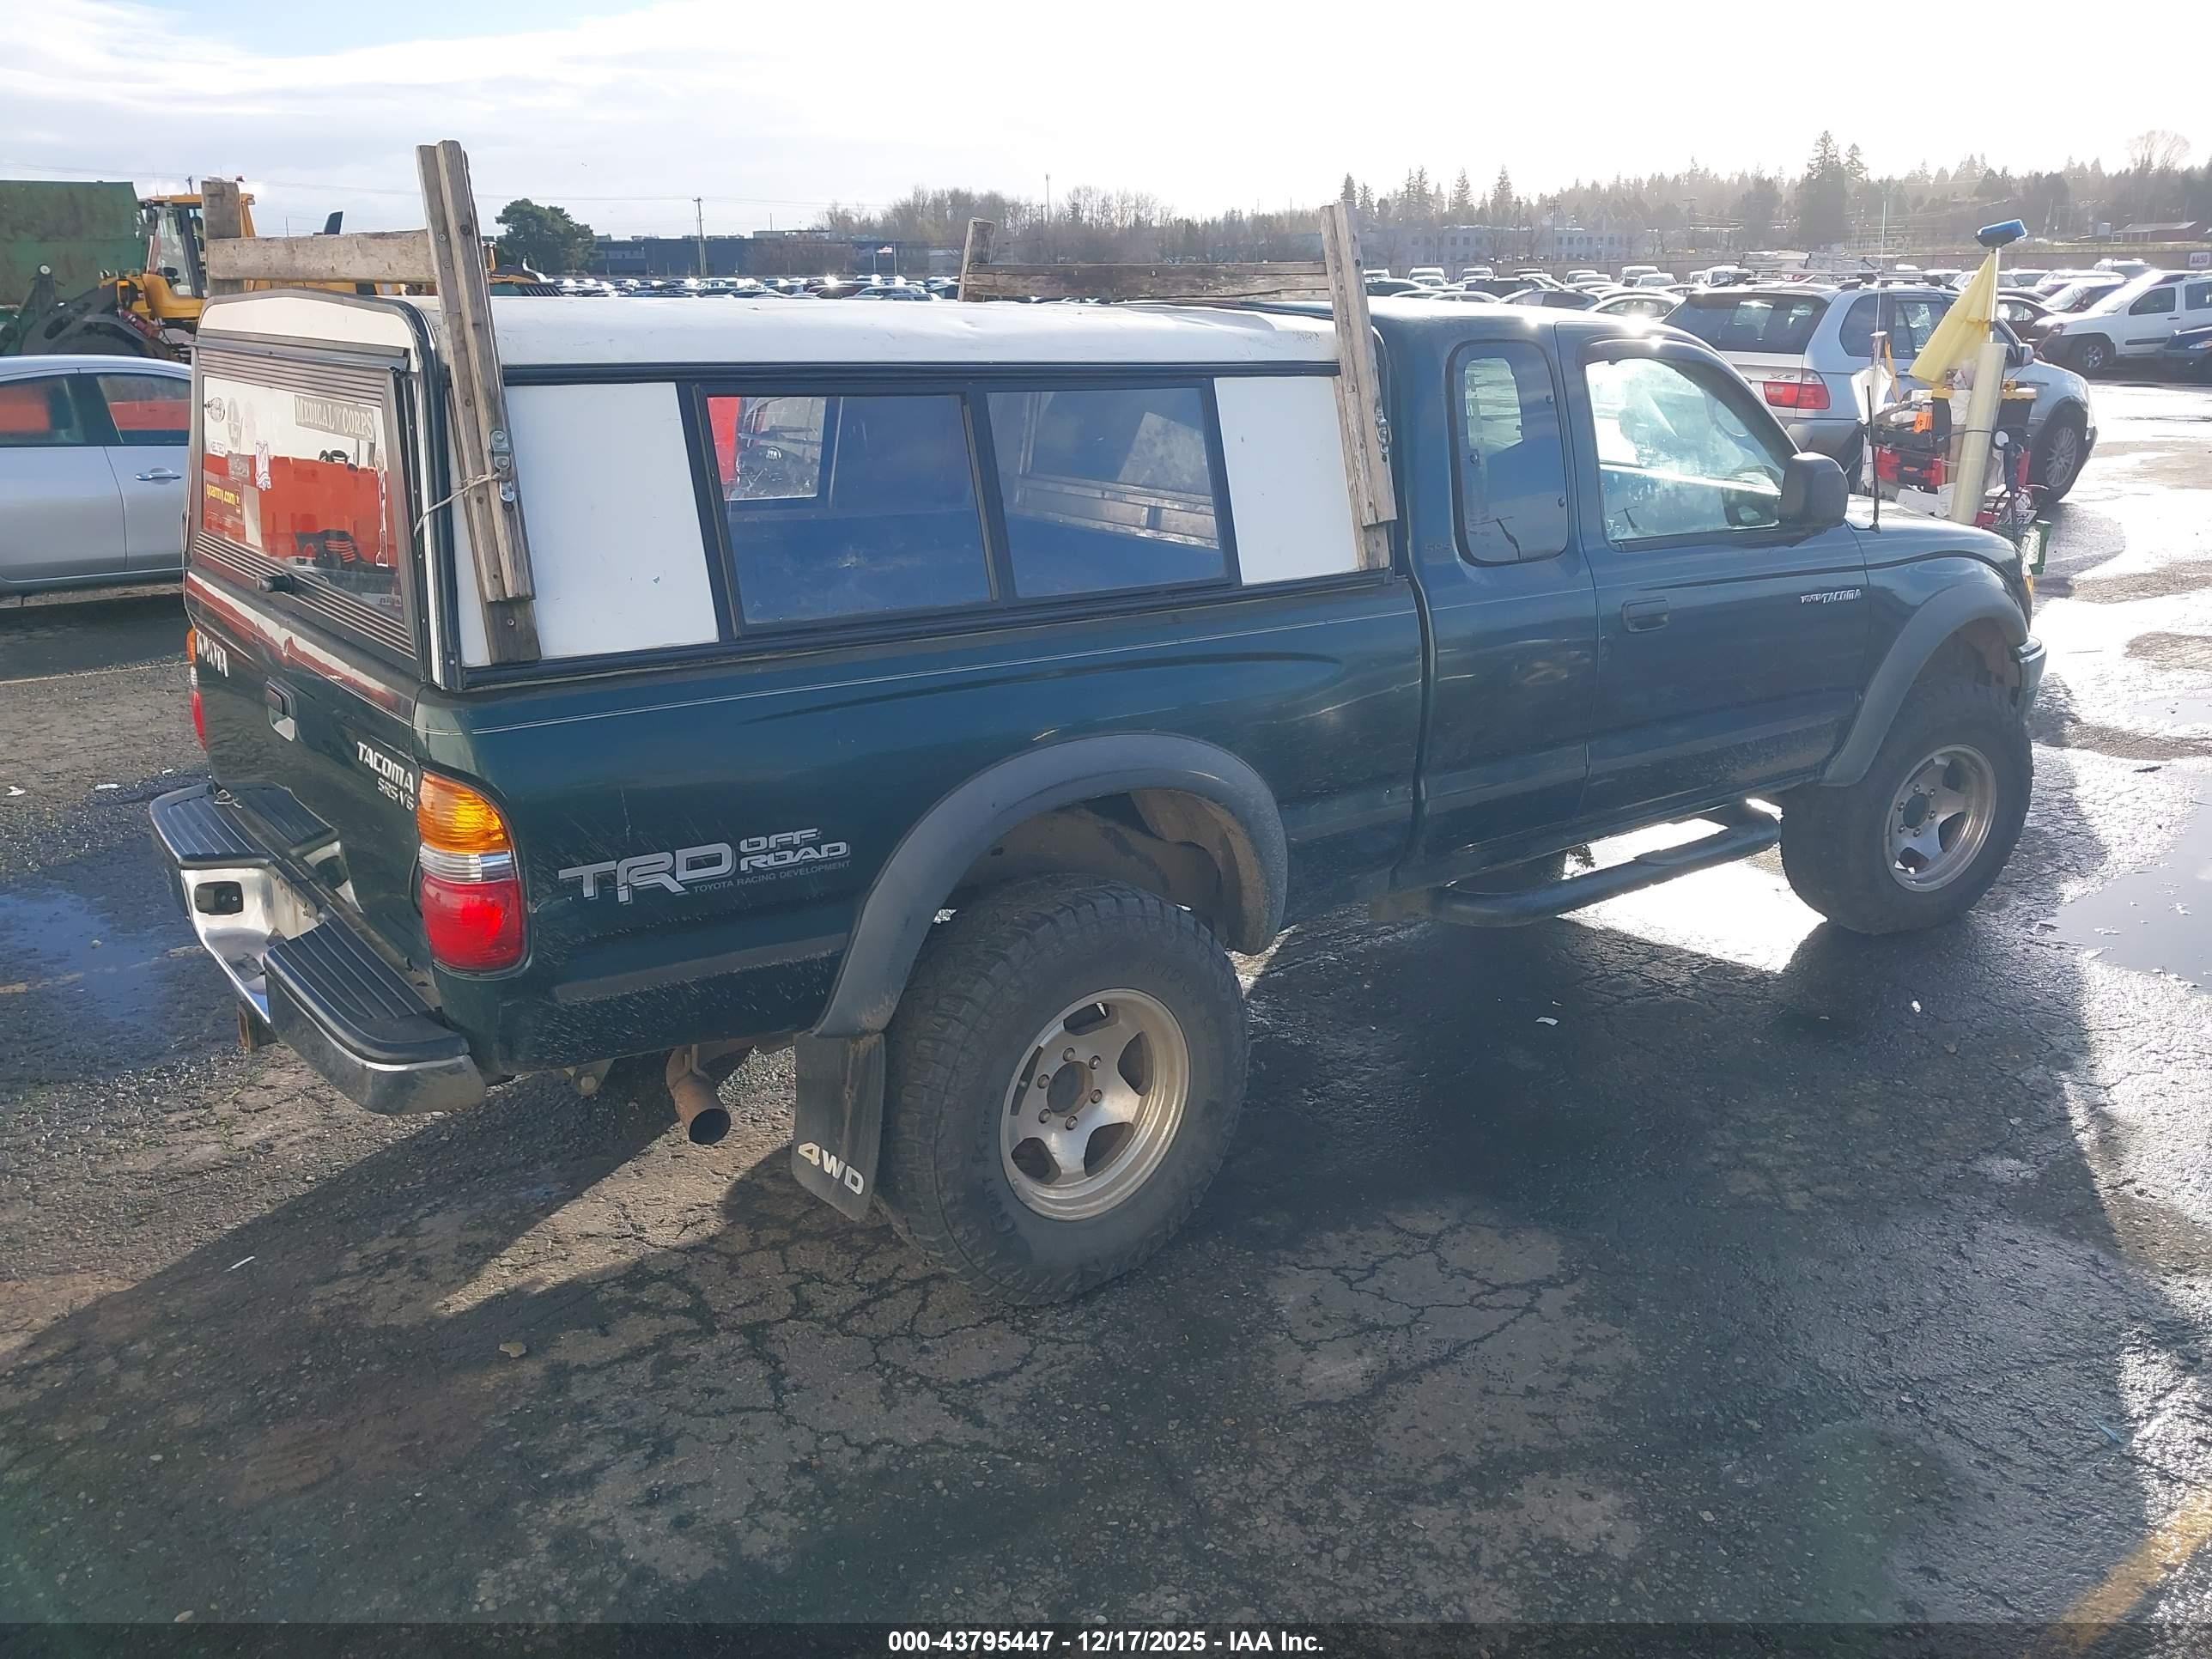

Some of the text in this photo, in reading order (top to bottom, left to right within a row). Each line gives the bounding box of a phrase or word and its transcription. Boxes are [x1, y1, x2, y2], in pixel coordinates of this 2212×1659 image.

[295, 398, 373, 439] MEDICAL CORPS
[195, 629, 229, 678] TOYOTA
[356, 741, 414, 795] TACOMA
[399, 790, 415, 811] V6
[739, 828, 820, 853] OFF
[739, 842, 849, 872] ROAD
[558, 842, 734, 904] TRD
[693, 860, 852, 894] TOYOTA RACING DEVELOPMENT
[798, 1142, 865, 1195] 4WD
